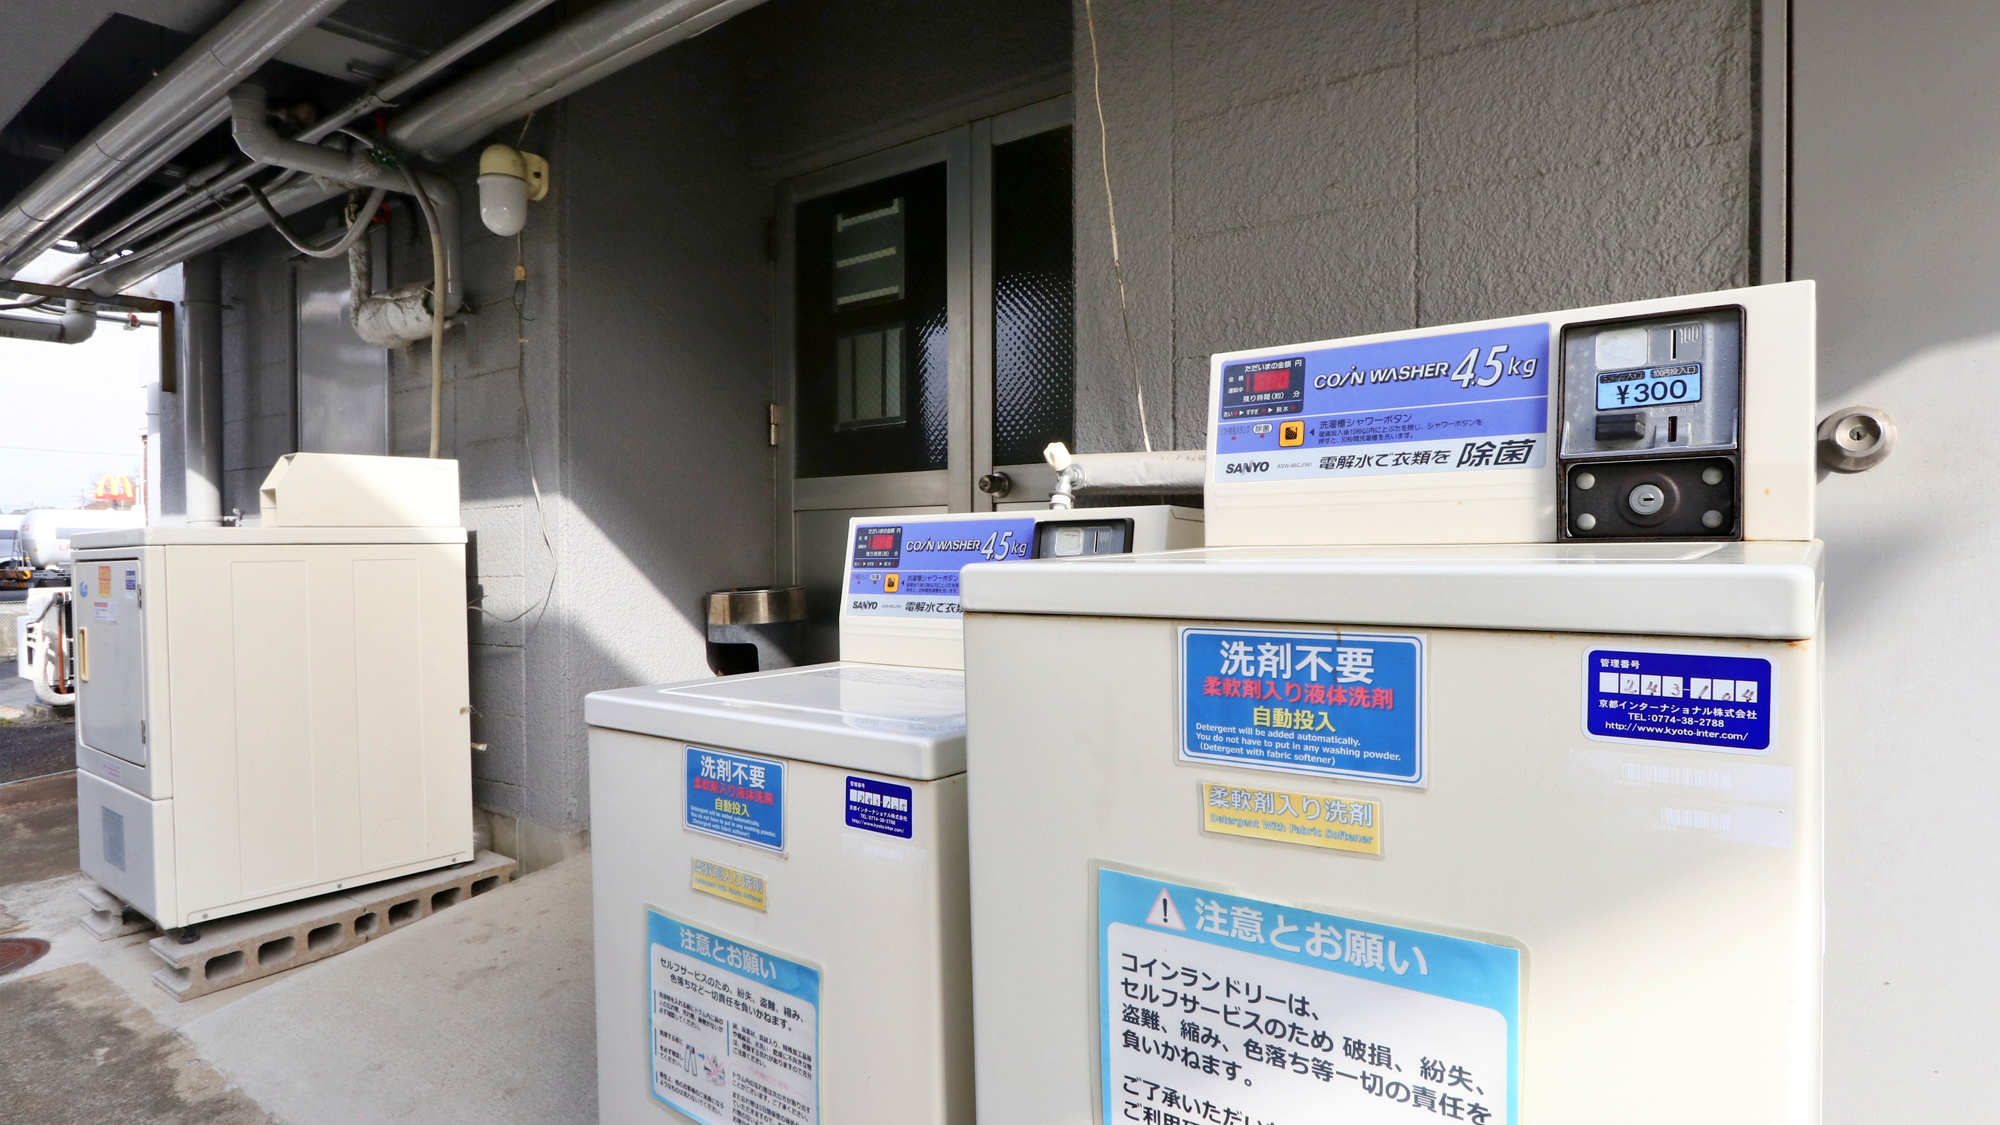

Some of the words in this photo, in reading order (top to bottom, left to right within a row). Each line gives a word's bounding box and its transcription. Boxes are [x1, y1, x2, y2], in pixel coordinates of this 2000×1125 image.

[1245, 361, 1292, 373] ただいまの金額
[1294, 359, 1303, 367] 円
[1313, 366, 1364, 390] COIN
[1370, 361, 1450, 384] WASHER
[1293, 390, 1300, 398] 分
[1616, 379, 1687, 405] ¥300
[1255, 424, 1270, 432] 除菌
[1320, 414, 1412, 429] 洗濯槽シャワーボタン
[1226, 461, 1270, 475] SANYO
[1319, 450, 1451, 470] 電解水で衣類を
[1456, 439, 1537, 468] 除菌
[905, 536, 935, 552] COIN
[937, 538, 981, 552] WASHER
[852, 601, 878, 611] SANYO
[1220, 640, 1375, 684] 洗剤不要
[1600, 658, 1640, 669] 管理番号
[1203, 676, 1394, 710] 柔軟剤入り液体洗剤
[1253, 705, 1337, 733] 自動投入
[1599, 699, 1758, 720] 京都インターナショナル株式会社
[1628, 712, 1725, 728] TEL:0774-38-2788
[1196, 722, 1236, 735] Detergent
[1238, 725, 1253, 735] will
[1255, 727, 1265, 737] be
[1267, 728, 1295, 740] added
[1297, 732, 1361, 747] automatically.
[1605, 721, 1749, 741] http://www.kyoto-inter.com/
[1196, 732, 1211, 741] You
[1213, 734, 1223, 742] do
[1225, 735, 1239, 744] not
[1241, 737, 1262, 747] have
[1264, 739, 1273, 748] to
[1275, 741, 1291, 751] put
[1293, 741, 1301, 750] in
[1303, 744, 1320, 754] any
[1322, 745, 1360, 758] washing
[1363, 749, 1401, 761] powder.
[1200, 742, 1244, 756] (Detergent
[1246, 746, 1265, 756] with
[1267, 748, 1291, 760] fabric
[1294, 752, 1336, 766] softener)
[701, 755, 766, 789] 洗剤不要
[694, 777, 774, 806] 柔軟剤入り液体洗剤
[690, 805, 708, 815] Detergent
[721, 812, 733, 820] added
[715, 797, 750, 818] 自動投入
[1209, 786, 1374, 827] 柔軟剤入り洗剤
[744, 824, 760, 834] washing
[1210, 813, 1259, 829] Detergent
[1263, 820, 1286, 832] With
[1290, 825, 1322, 838] Fabric
[1325, 829, 1373, 844] Softener
[695, 860, 763, 893] 柔軟剤入り洗剤
[1194, 897, 1429, 977] 注意とお願い
[680, 926, 777, 980] 注意とお願い
[1121, 953, 1320, 1021] コインランドリーは、
[670, 973, 792, 1032] 色落ちなど一切責任を負いかねます。
[1120, 977, 1334, 1053] セルフサービスのため
[1342, 1035, 1485, 1096] 破損、紛失、
[1121, 1030, 1253, 1088] 負いかねます。
[1121, 1004, 1492, 1125] 盗難、縮み、色落ち等一切の責任を
